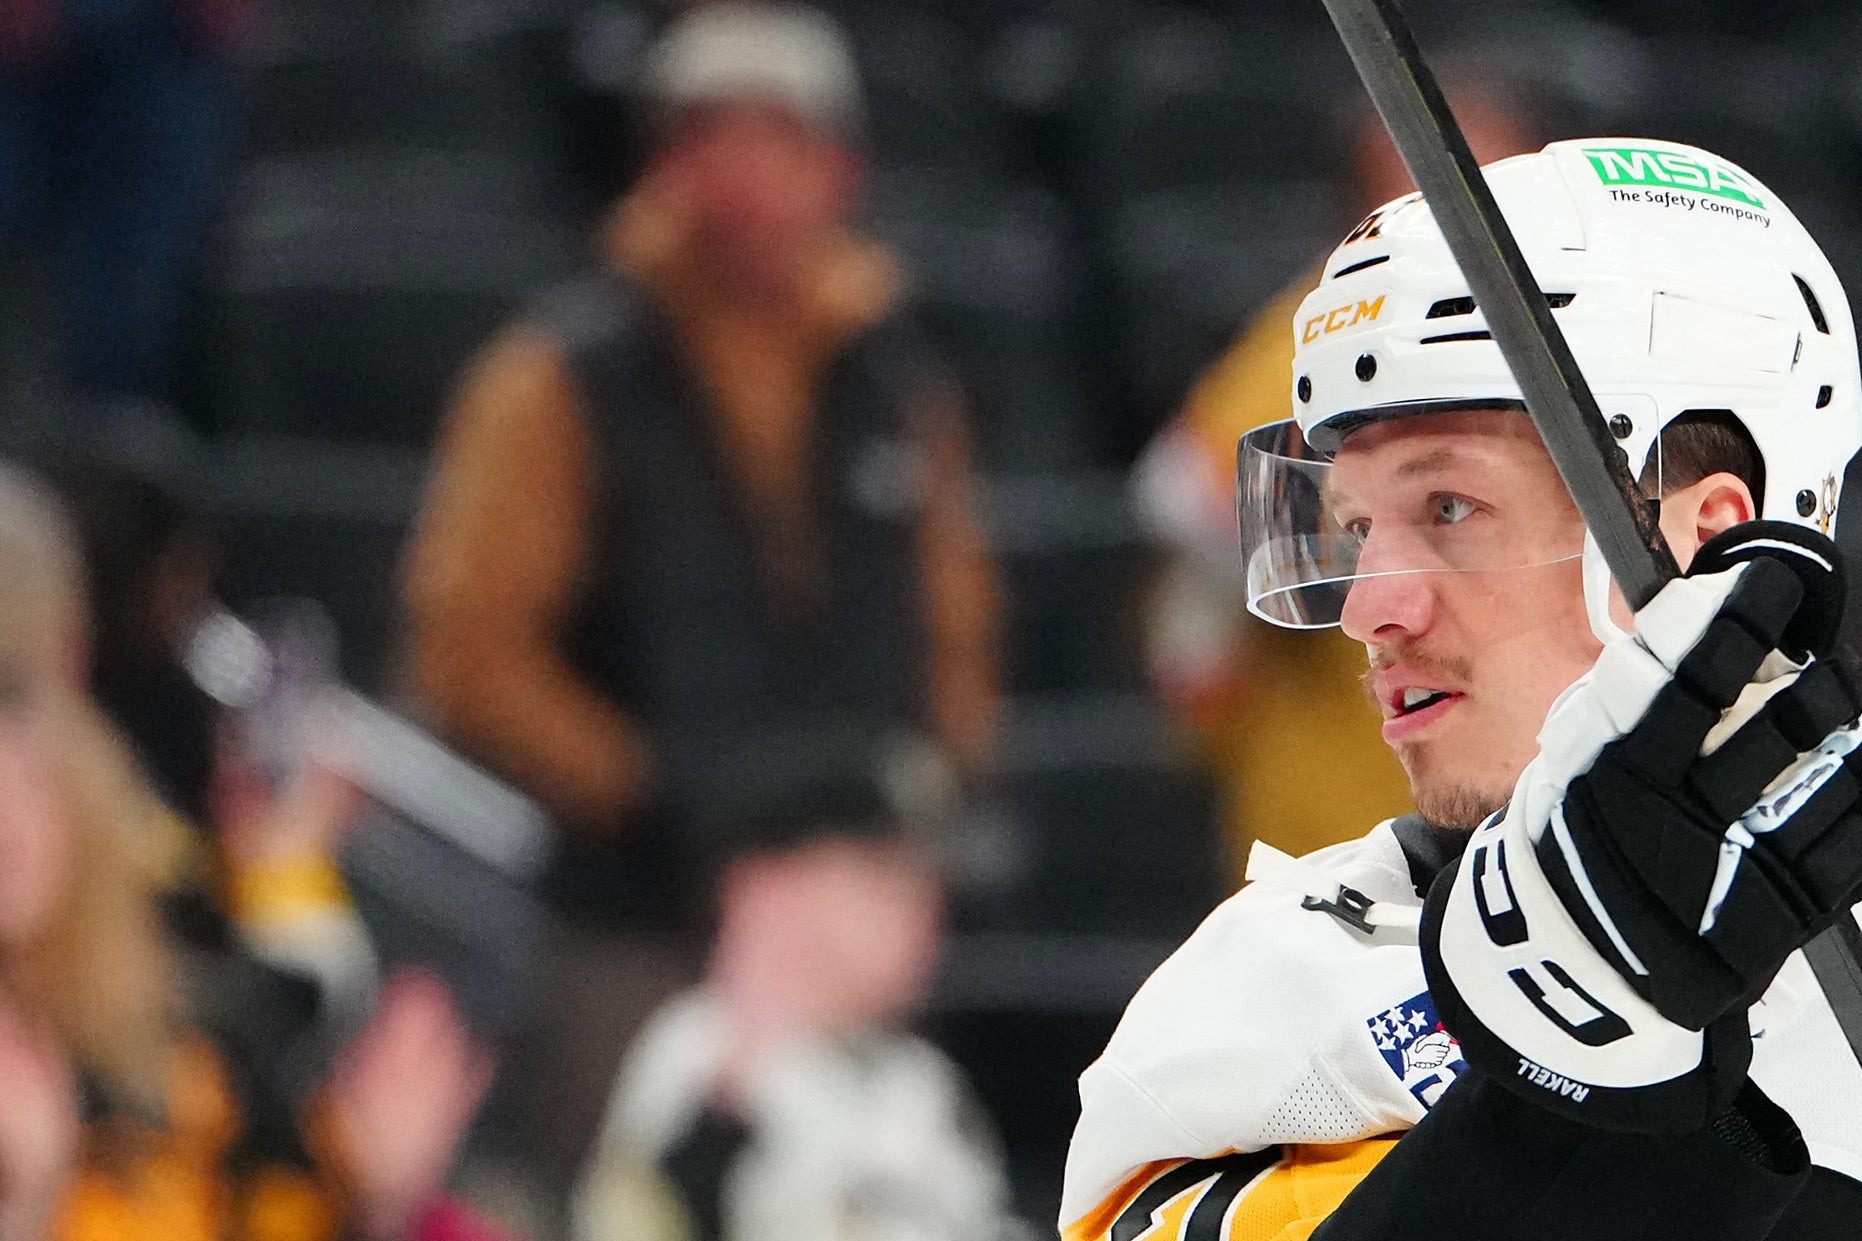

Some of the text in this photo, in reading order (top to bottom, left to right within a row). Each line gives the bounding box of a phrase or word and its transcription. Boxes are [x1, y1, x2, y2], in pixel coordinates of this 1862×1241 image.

[1584, 150, 1763, 204] MSA
[1609, 189, 1771, 228] The Safety Company
[1302, 294, 1387, 345] CCM
[1473, 805, 1634, 1048] CC
[1517, 1057, 1591, 1104] RAKELL
